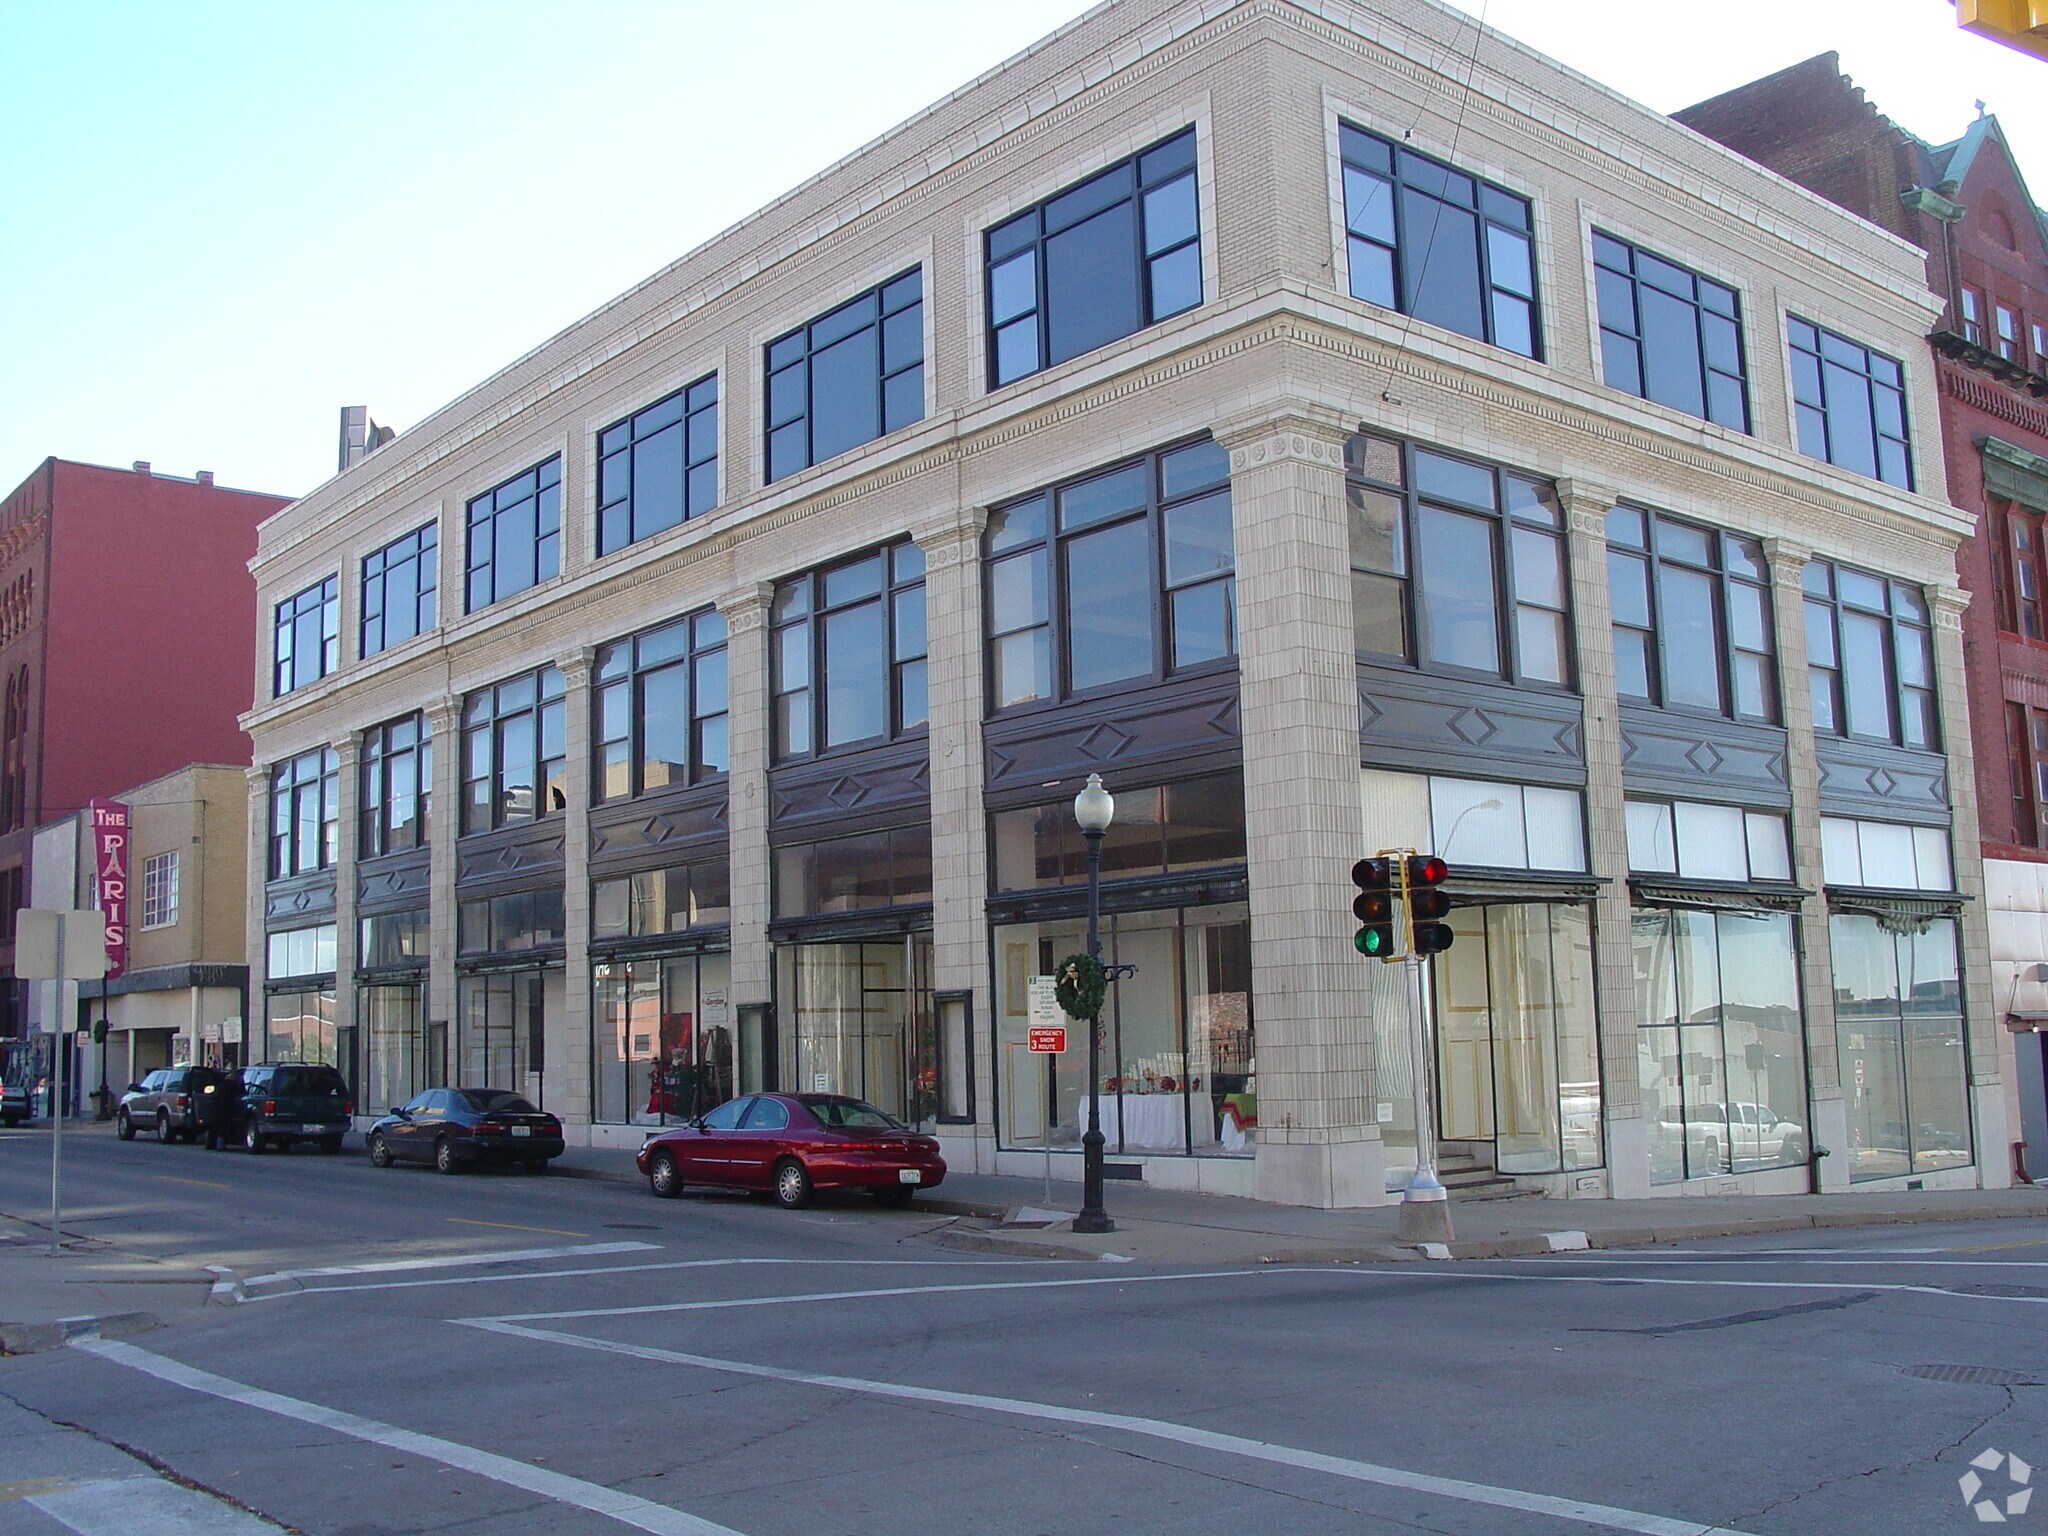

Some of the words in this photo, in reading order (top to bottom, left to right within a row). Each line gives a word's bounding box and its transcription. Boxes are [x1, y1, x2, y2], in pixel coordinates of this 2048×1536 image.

[96, 809, 126, 827] THE
[101, 834, 126, 946] PARIS
[1031, 1040, 1037, 1050] 3
